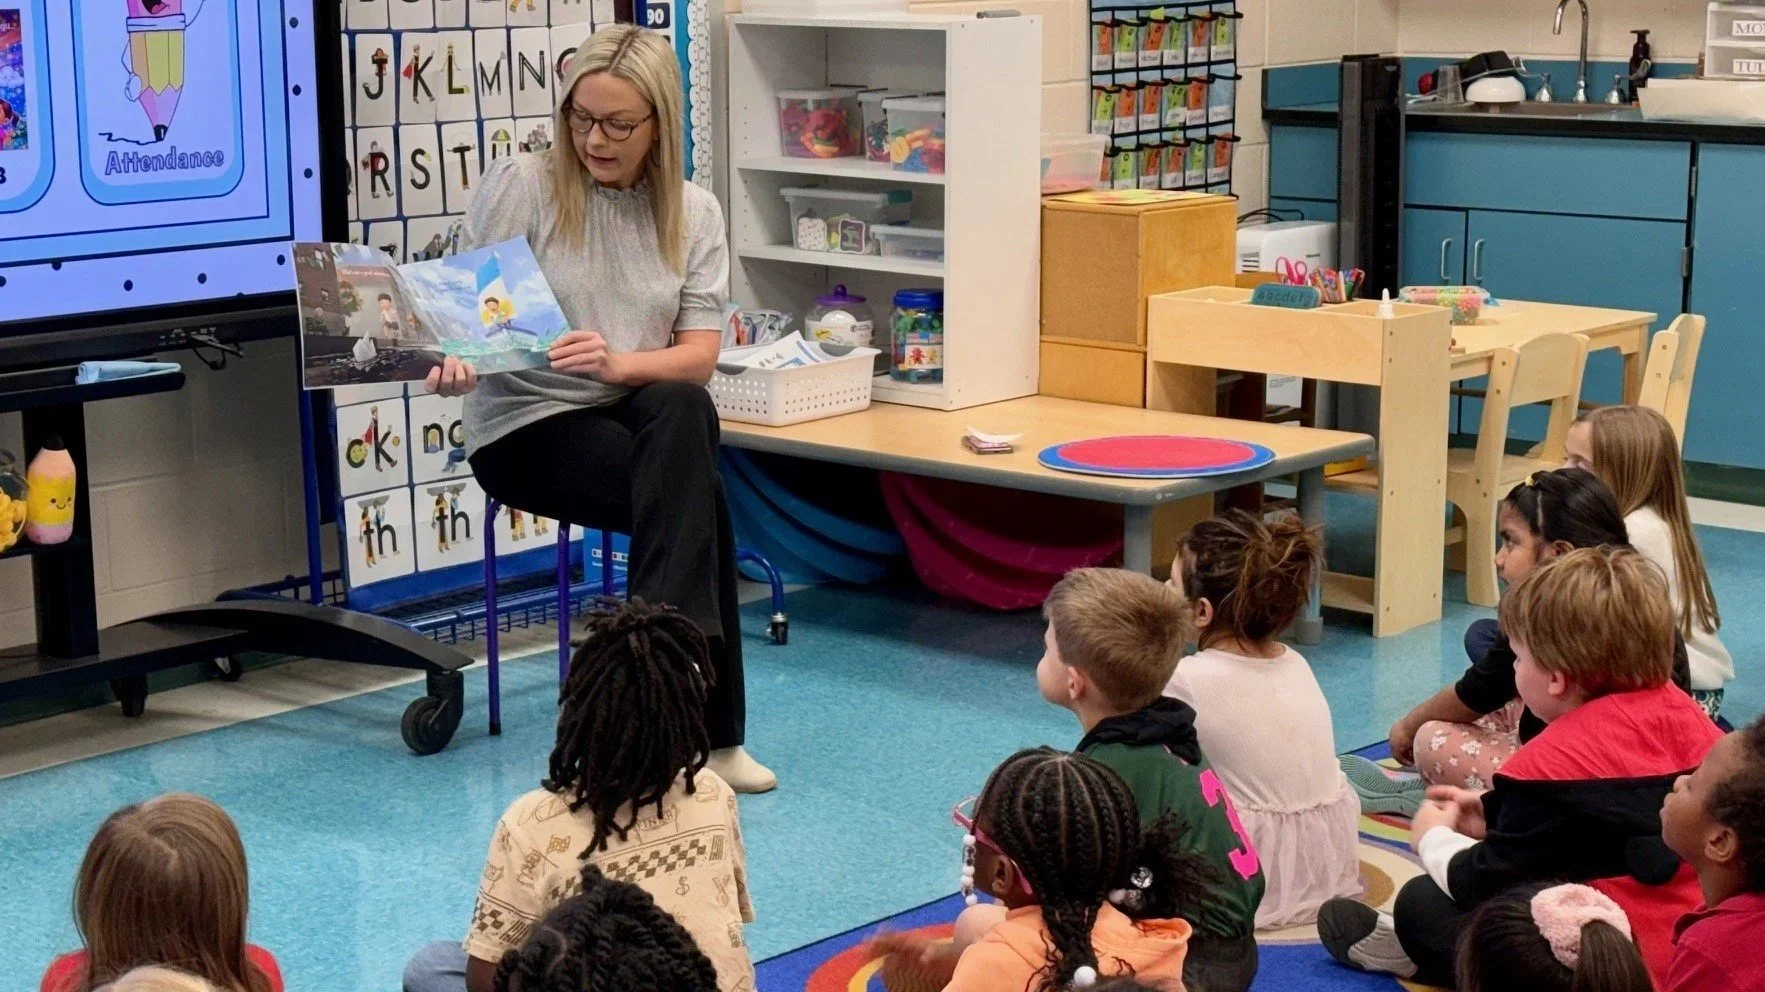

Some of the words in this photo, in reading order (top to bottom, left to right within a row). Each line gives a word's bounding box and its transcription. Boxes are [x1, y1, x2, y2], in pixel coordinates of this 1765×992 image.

[646, 8, 665, 26] 90
[1735, 22, 1765, 35] MO
[362, 57, 389, 101] J
[412, 54, 435, 102] K
[447, 53, 465, 95] L
[479, 60, 502, 95] M
[518, 50, 546, 91] N
[104, 145, 225, 176] Attendance
[368, 151, 392, 195] R
[409, 147, 431, 190] S
[452, 144, 472, 187] T
[345, 417, 395, 469] ck
[363, 508, 398, 558] th
[435, 502, 471, 543] th
